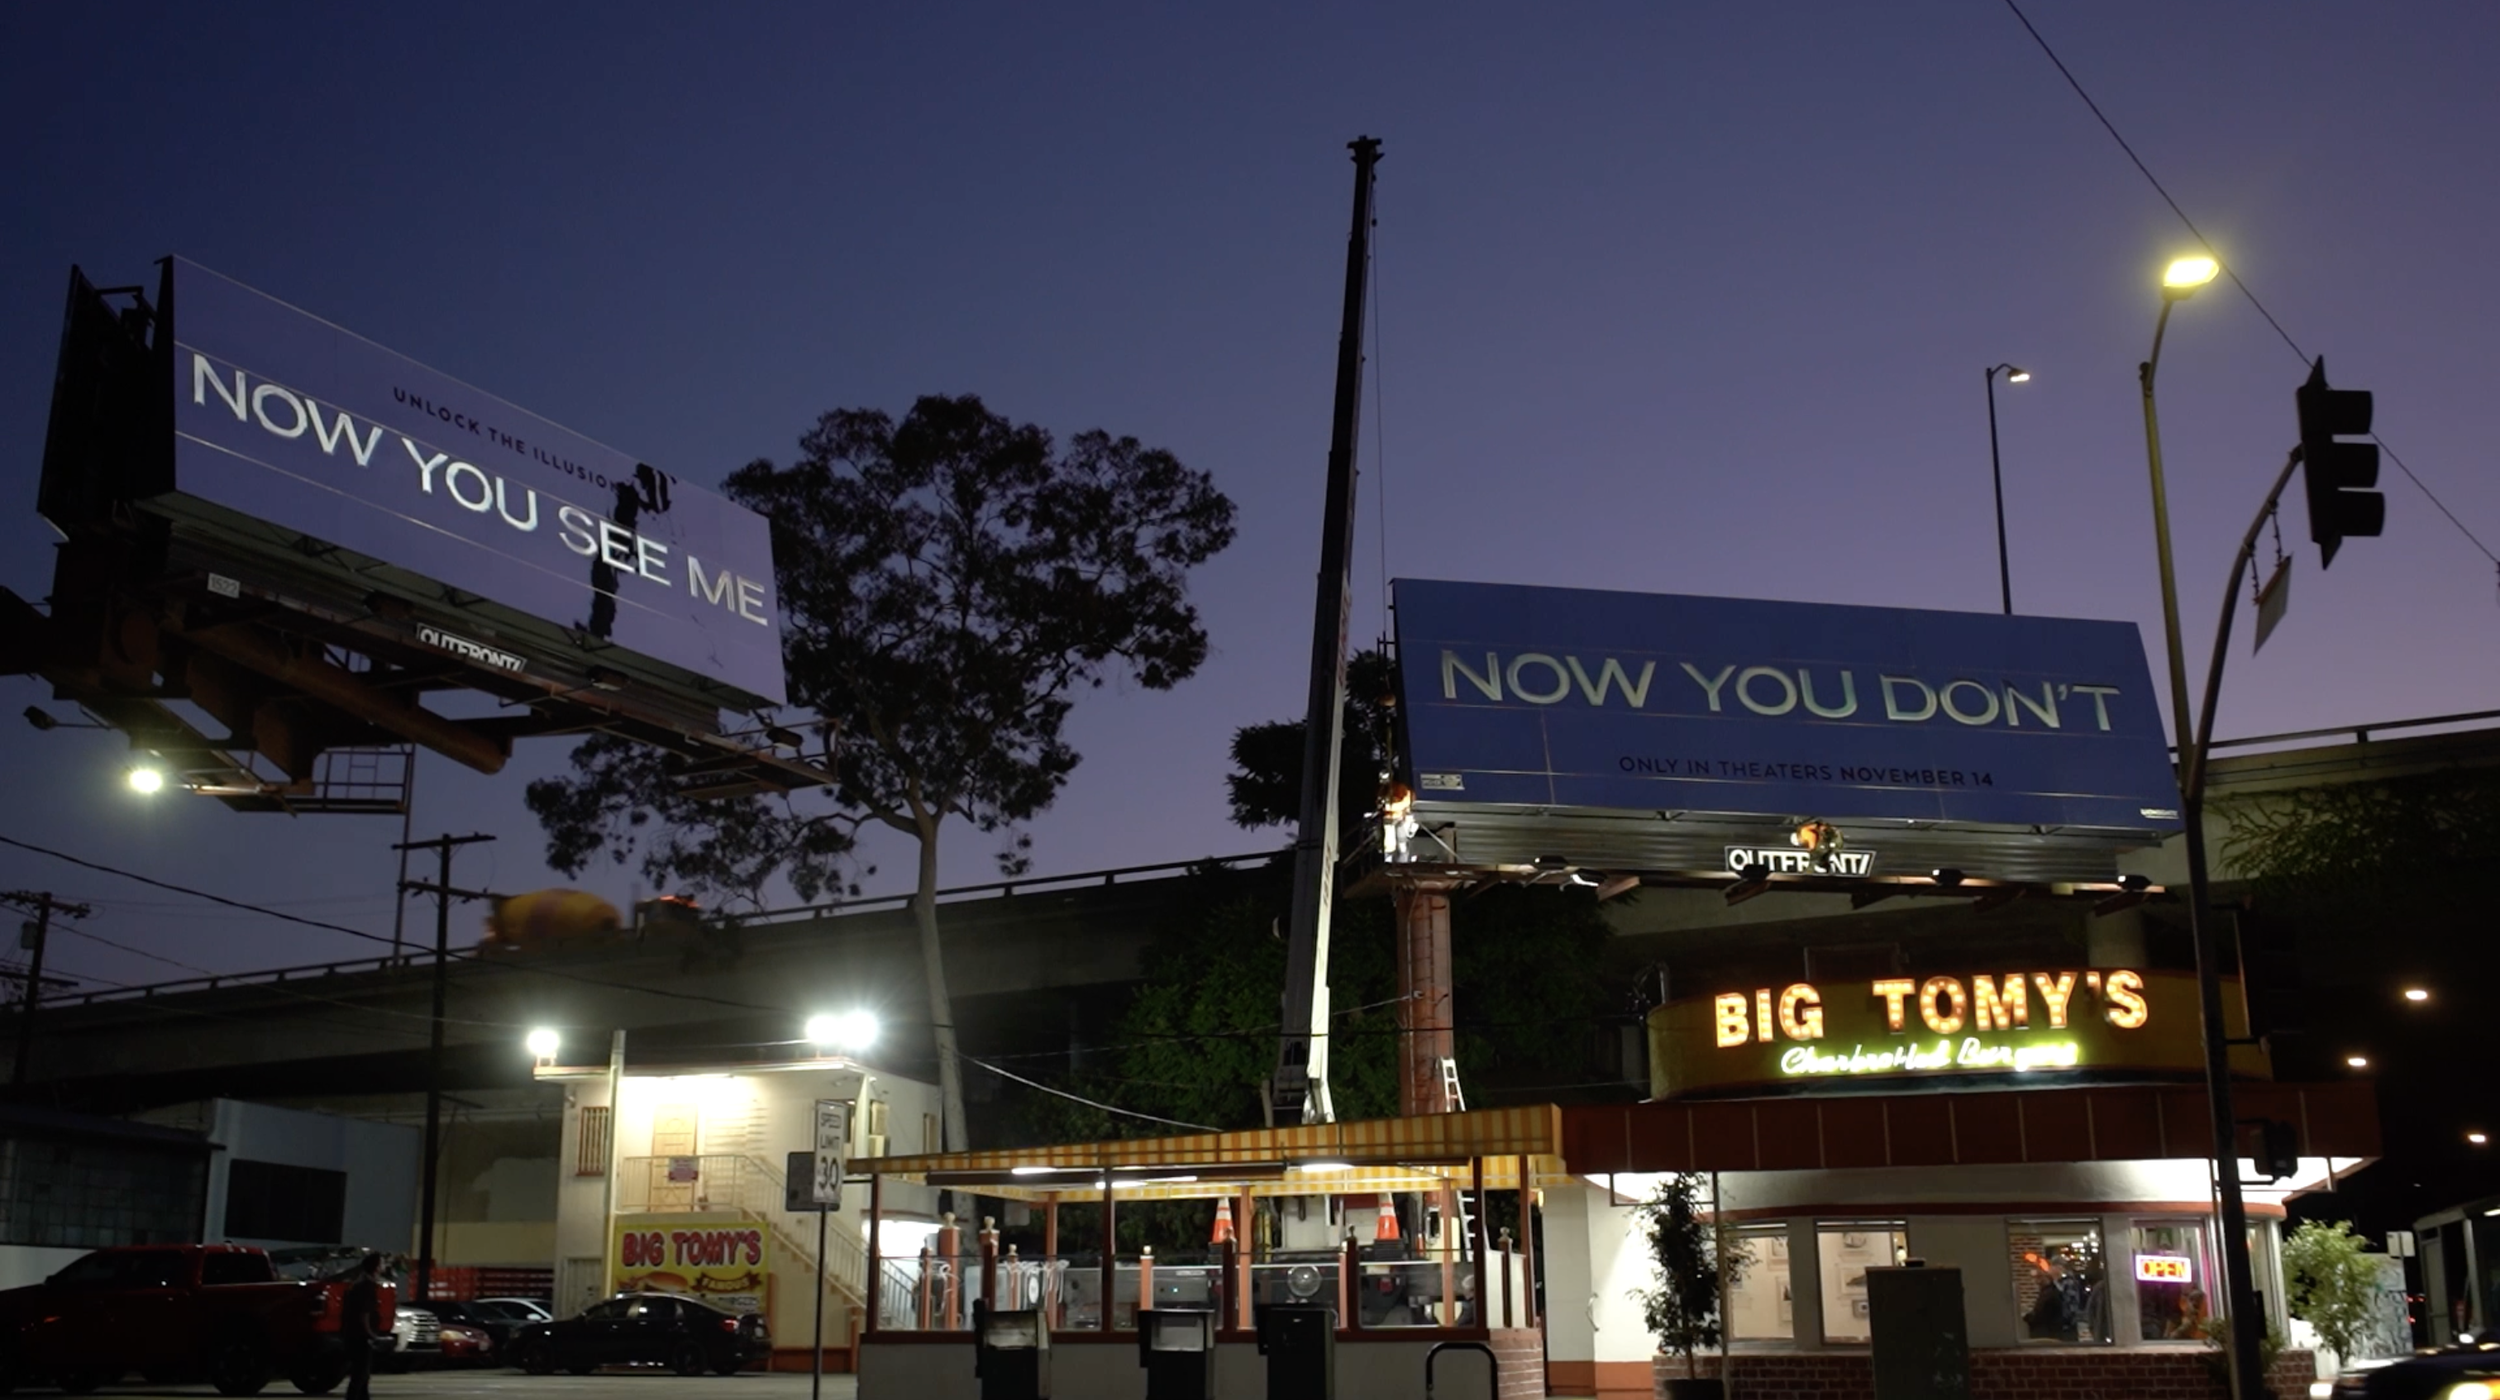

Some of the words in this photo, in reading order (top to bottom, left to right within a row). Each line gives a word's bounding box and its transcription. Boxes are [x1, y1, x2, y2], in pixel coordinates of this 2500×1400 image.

[393, 386, 481, 435] UNLOCK
[488, 427, 525, 455] THE
[193, 353, 383, 468] NOW
[401, 436, 539, 532] YOU
[558, 505, 672, 587] SEE
[687, 555, 769, 627] ME
[1441, 649, 1657, 709] NOW
[1678, 660, 1859, 719] YOU
[1879, 673, 2121, 732] DON'T
[1618, 755, 1679, 774] ONLY
[1687, 759, 1710, 775] IN
[1717, 760, 1833, 781] THEATERS
[1839, 766, 1966, 786] NOVEMBER
[1971, 771, 1993, 787] 14
[1715, 983, 1824, 1049] BIG
[1872, 969, 2149, 1035] TOMY'S
[821, 1112, 841, 1129] SPEED
[820, 1133, 841, 1151] LIMIT
[818, 1155, 839, 1192] 30
[621, 1231, 666, 1268] BIG
[670, 1229, 762, 1268] TOMY'S
[2142, 1260, 2186, 1278] OPEN
